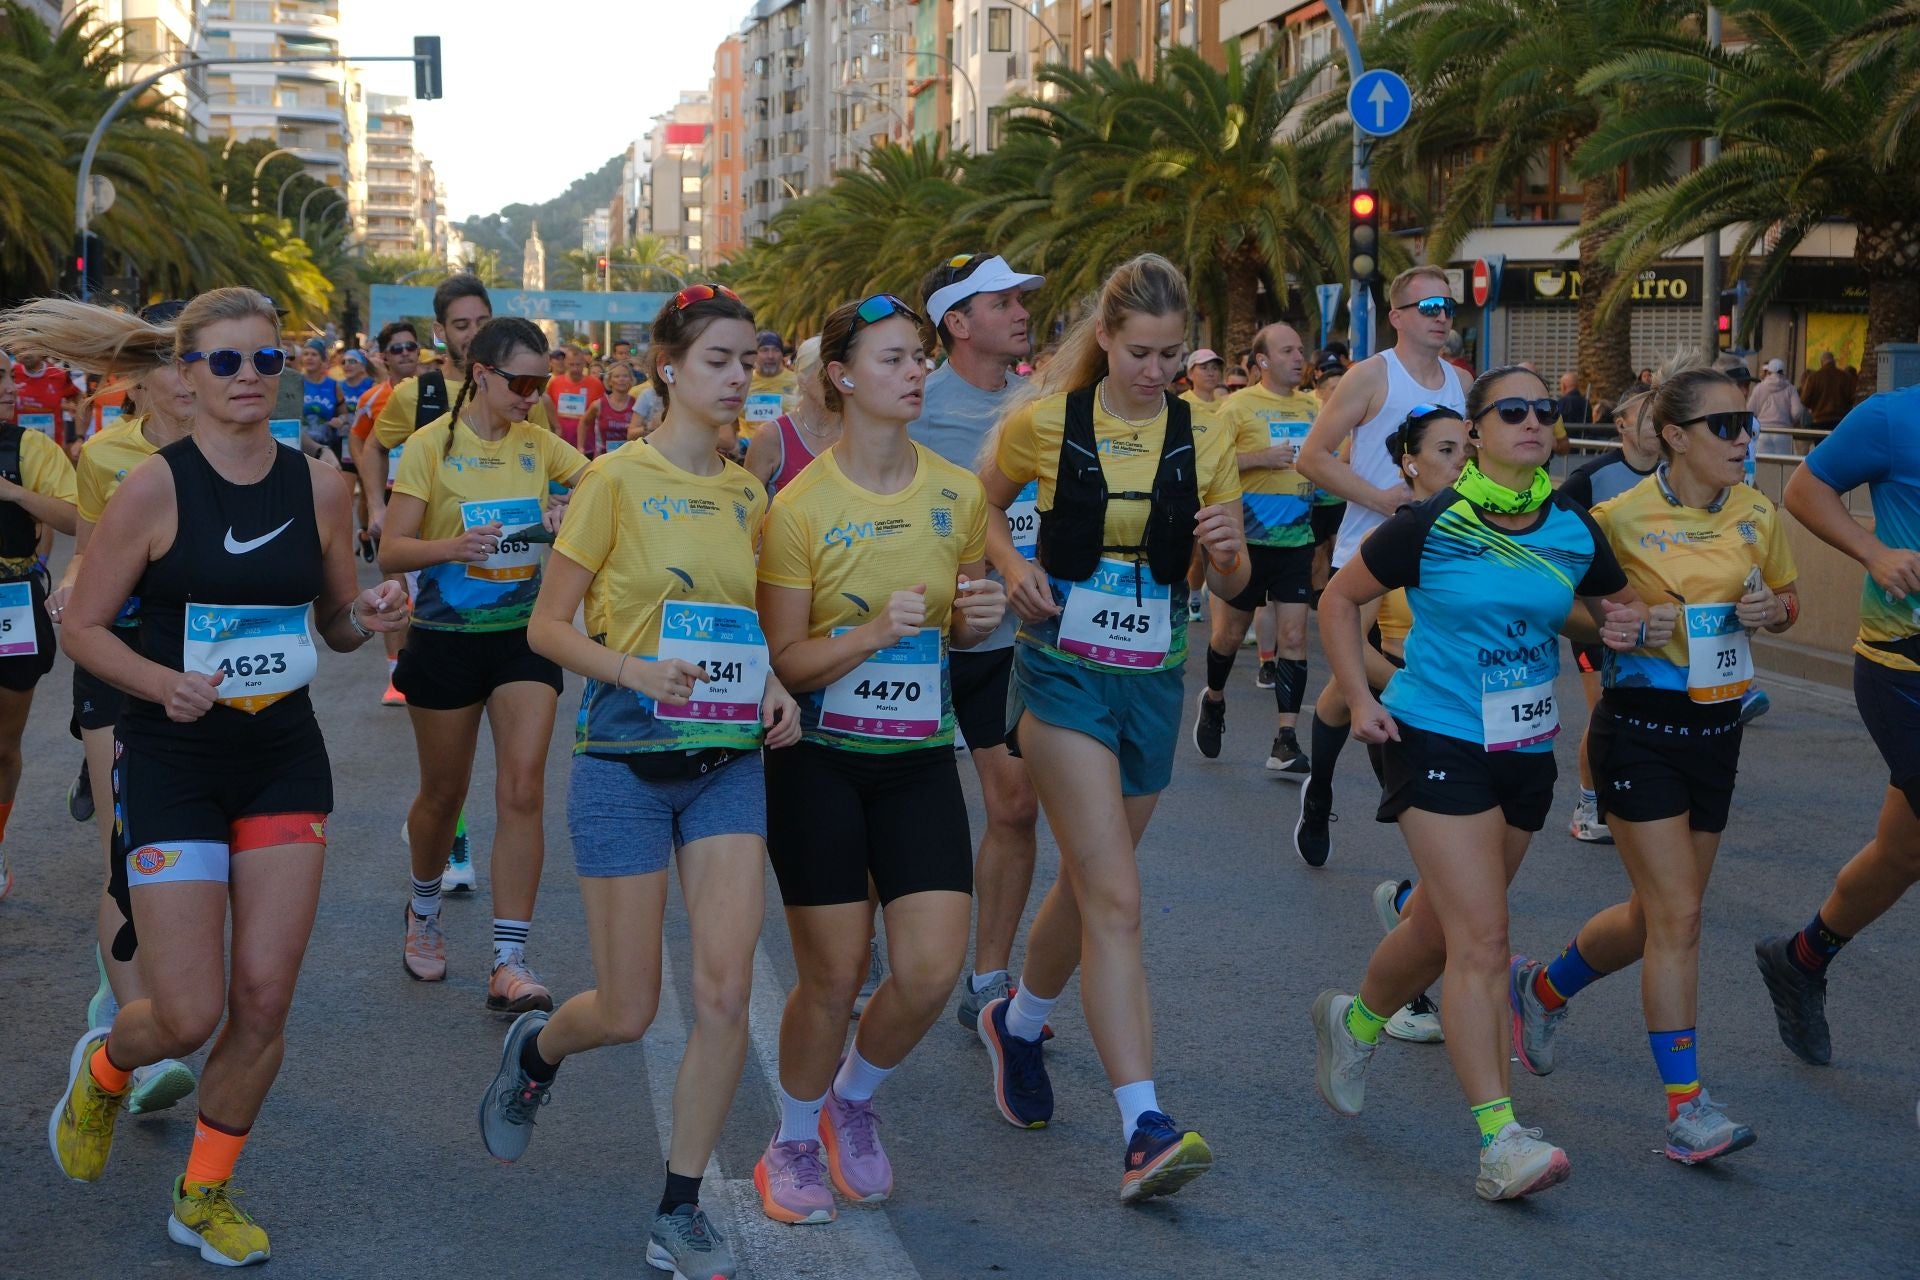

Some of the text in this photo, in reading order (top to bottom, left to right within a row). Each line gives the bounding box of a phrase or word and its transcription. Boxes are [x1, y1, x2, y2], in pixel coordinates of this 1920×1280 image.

[1103, 571, 1120, 586] VI
[0, 619, 12, 632] 5
[221, 618, 240, 632] VI
[697, 615, 714, 632] VI
[1092, 609, 1150, 634] 4145
[1108, 634, 1132, 642] Adinka
[217, 652, 287, 678] 4623
[1717, 649, 1737, 669] 733
[1512, 666, 1528, 680] VI
[709, 686, 728, 695] Sharyk
[854, 680, 920, 702] 4470
[876, 704, 898, 712] Marisa
[1511, 696, 1552, 723] 1345
